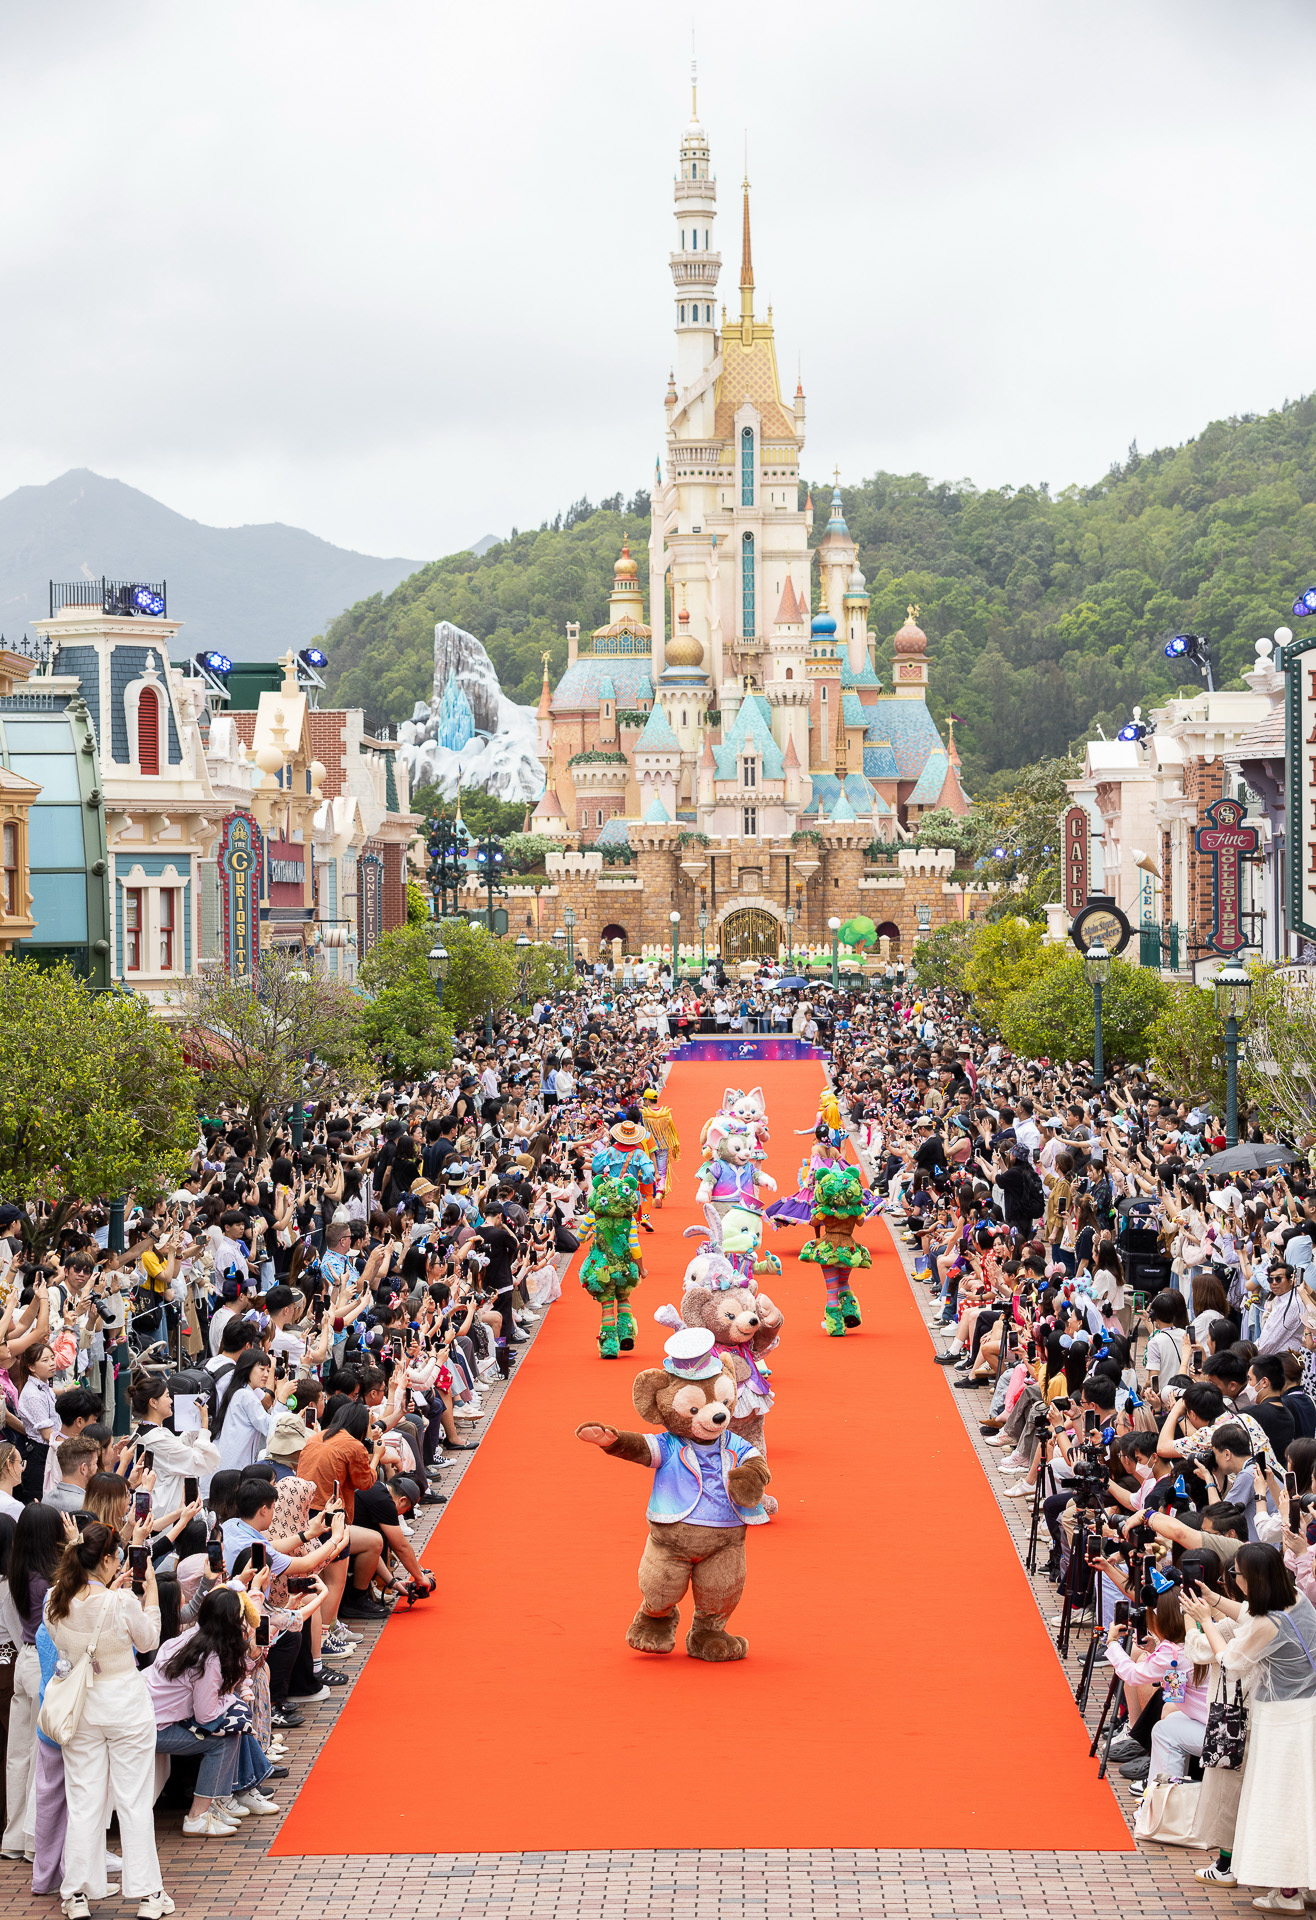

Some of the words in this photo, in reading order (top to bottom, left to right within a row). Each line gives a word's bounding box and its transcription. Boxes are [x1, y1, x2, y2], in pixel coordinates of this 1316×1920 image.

[1070, 818, 1083, 907] CAFE
[1206, 832, 1250, 848] Fine
[231, 852, 248, 975] CURIOSITY
[366, 867, 376, 952] CONFECTION
[1084, 924, 1098, 935] Main
[1099, 918, 1116, 930] Street
[1143, 875, 1152, 905] ICE
[1221, 847, 1236, 945] COLLECTIBLES
